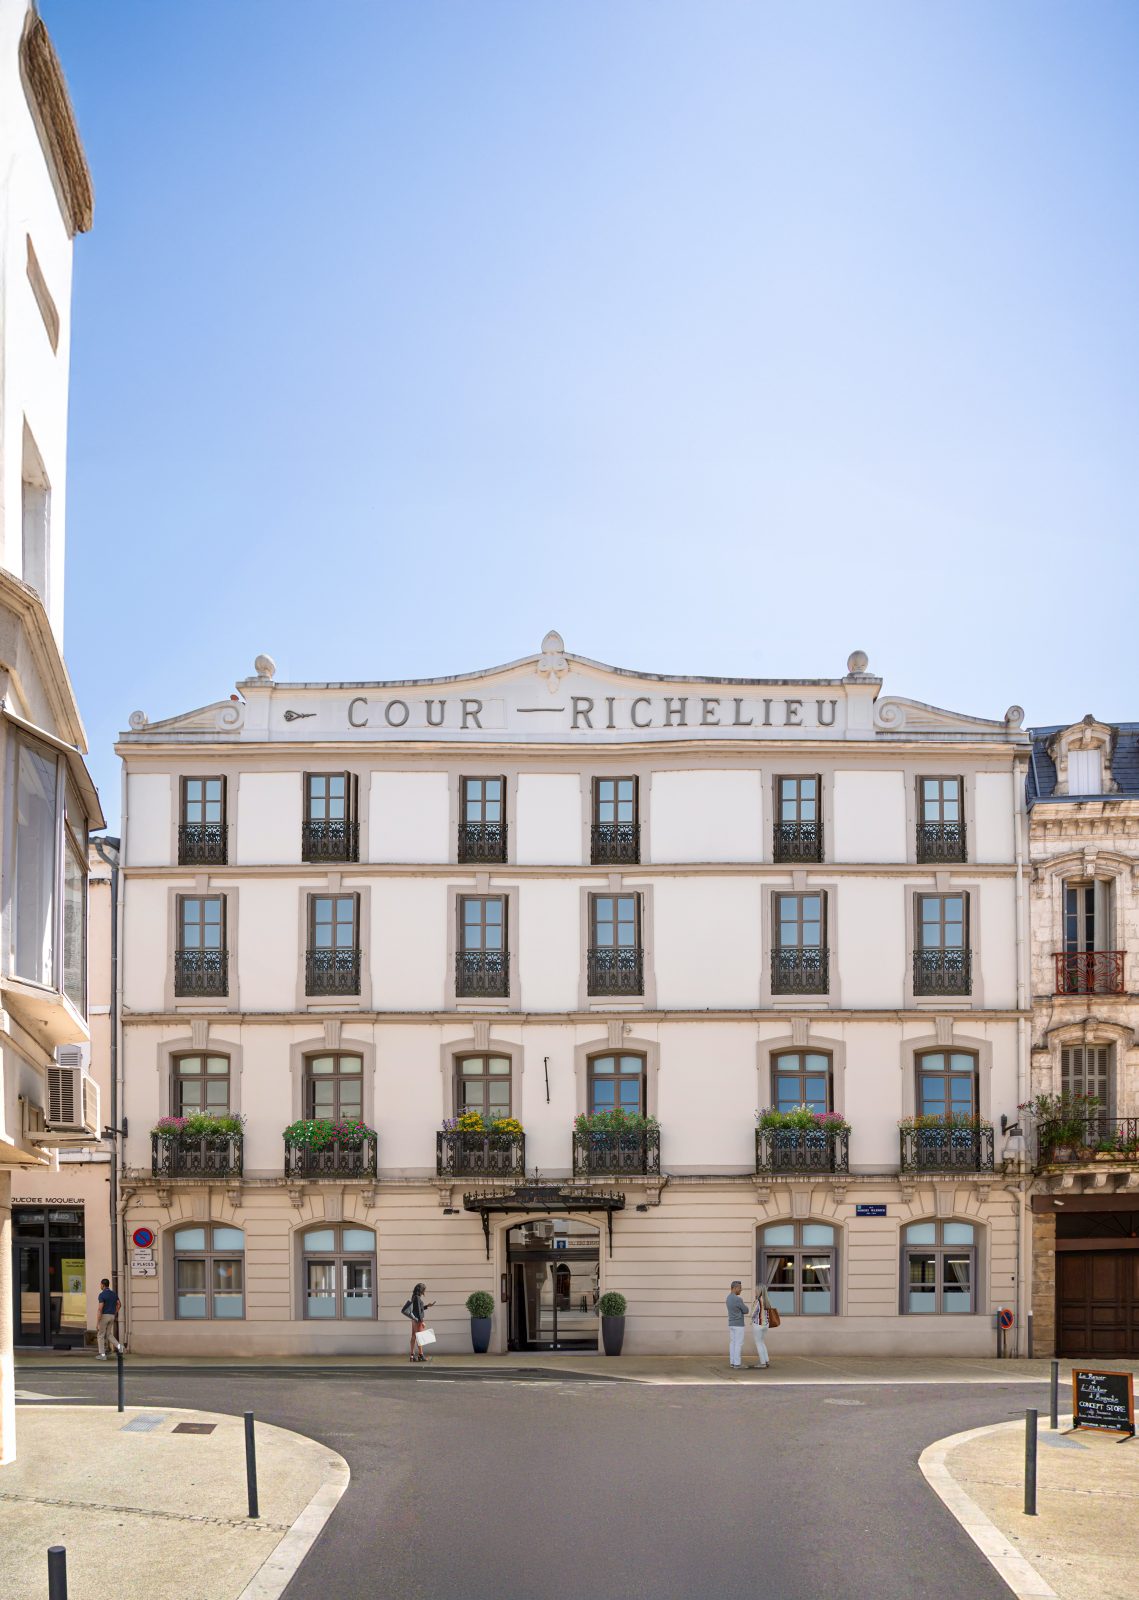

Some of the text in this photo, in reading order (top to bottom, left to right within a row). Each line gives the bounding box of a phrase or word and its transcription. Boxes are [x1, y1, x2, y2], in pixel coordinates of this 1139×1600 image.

[348, 696, 838, 729] COUR RICHELIEU
[1079, 1401, 1103, 1410] CONCEPT
[1106, 1405, 1126, 1413] STORE
